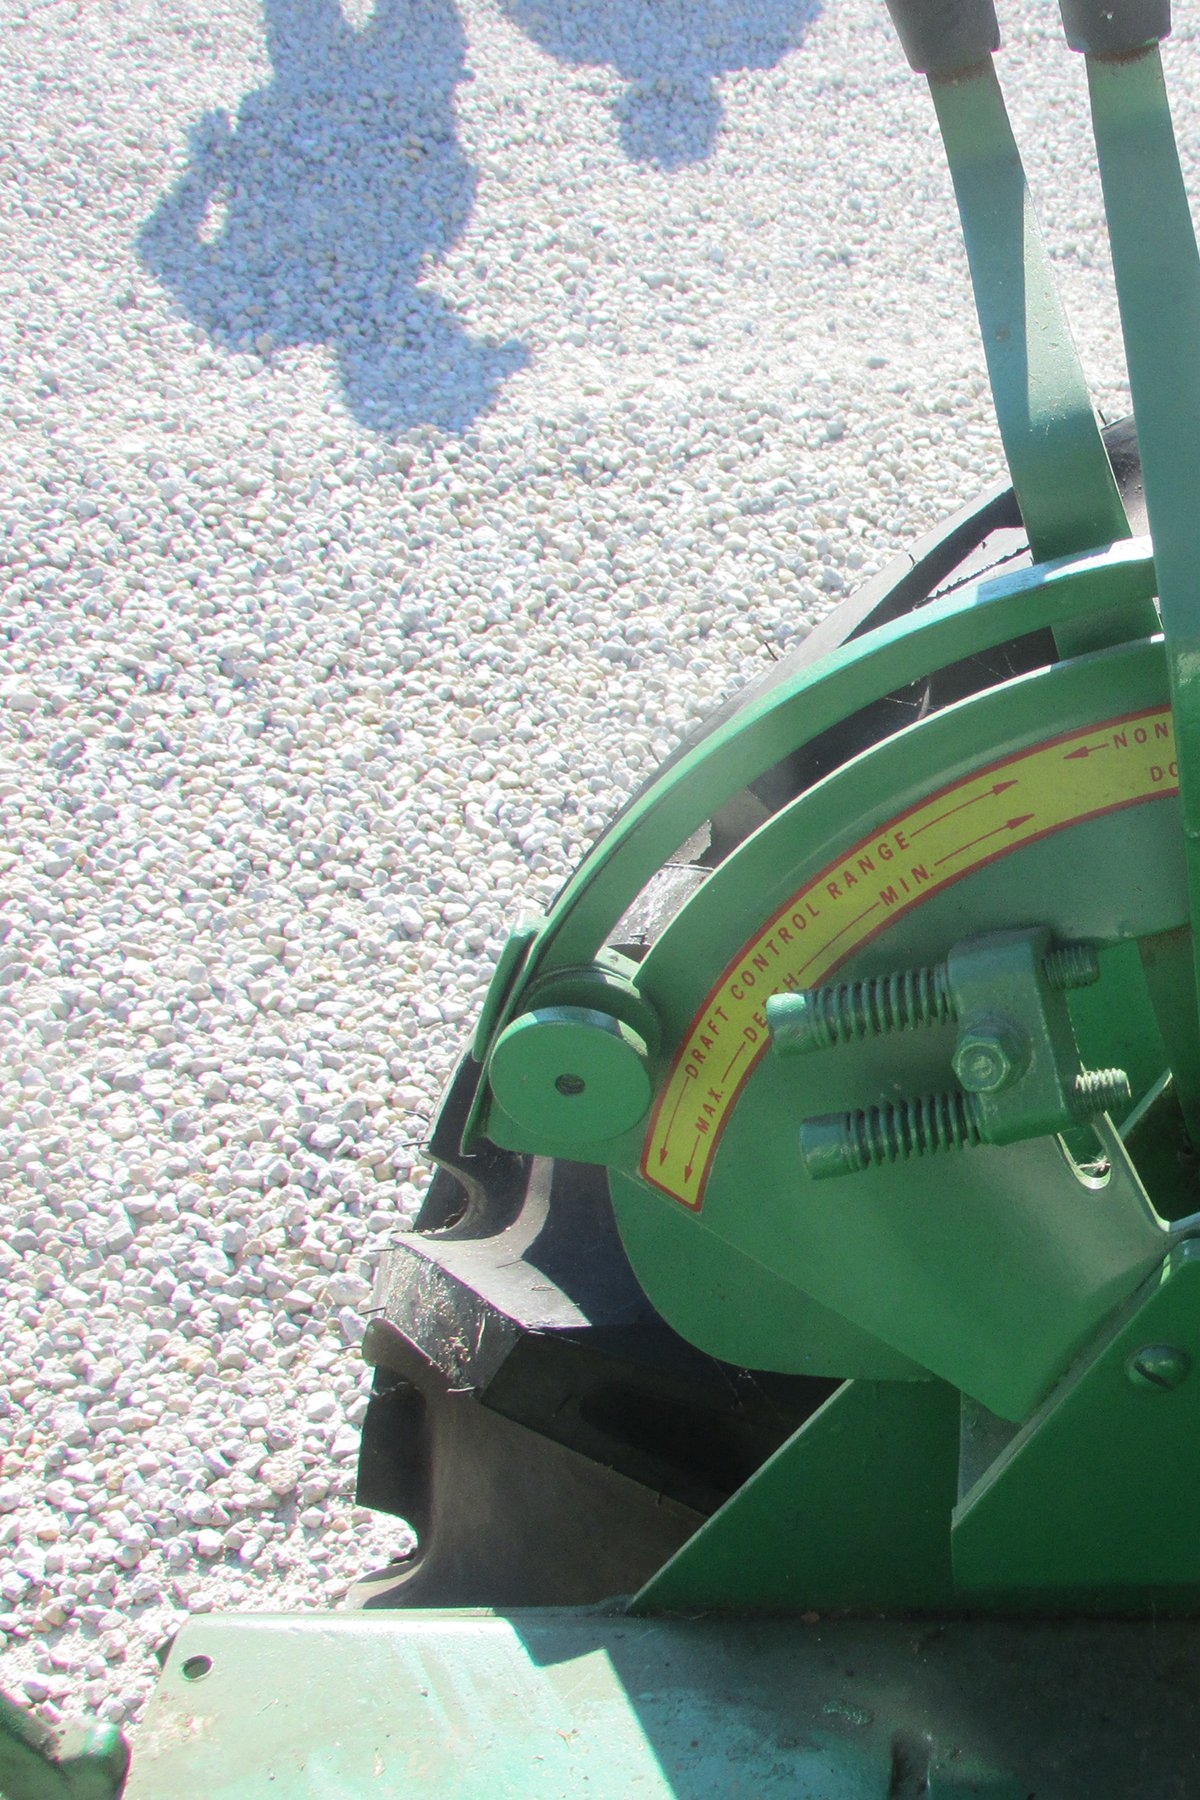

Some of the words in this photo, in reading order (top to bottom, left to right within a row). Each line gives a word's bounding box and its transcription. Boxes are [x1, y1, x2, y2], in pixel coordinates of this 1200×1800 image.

[685, 1008, 729, 1079] DRAFT
[730, 901, 820, 1000] CONTROL
[827, 832, 910, 899] RANGE
[743, 972, 799, 1044] DEH
